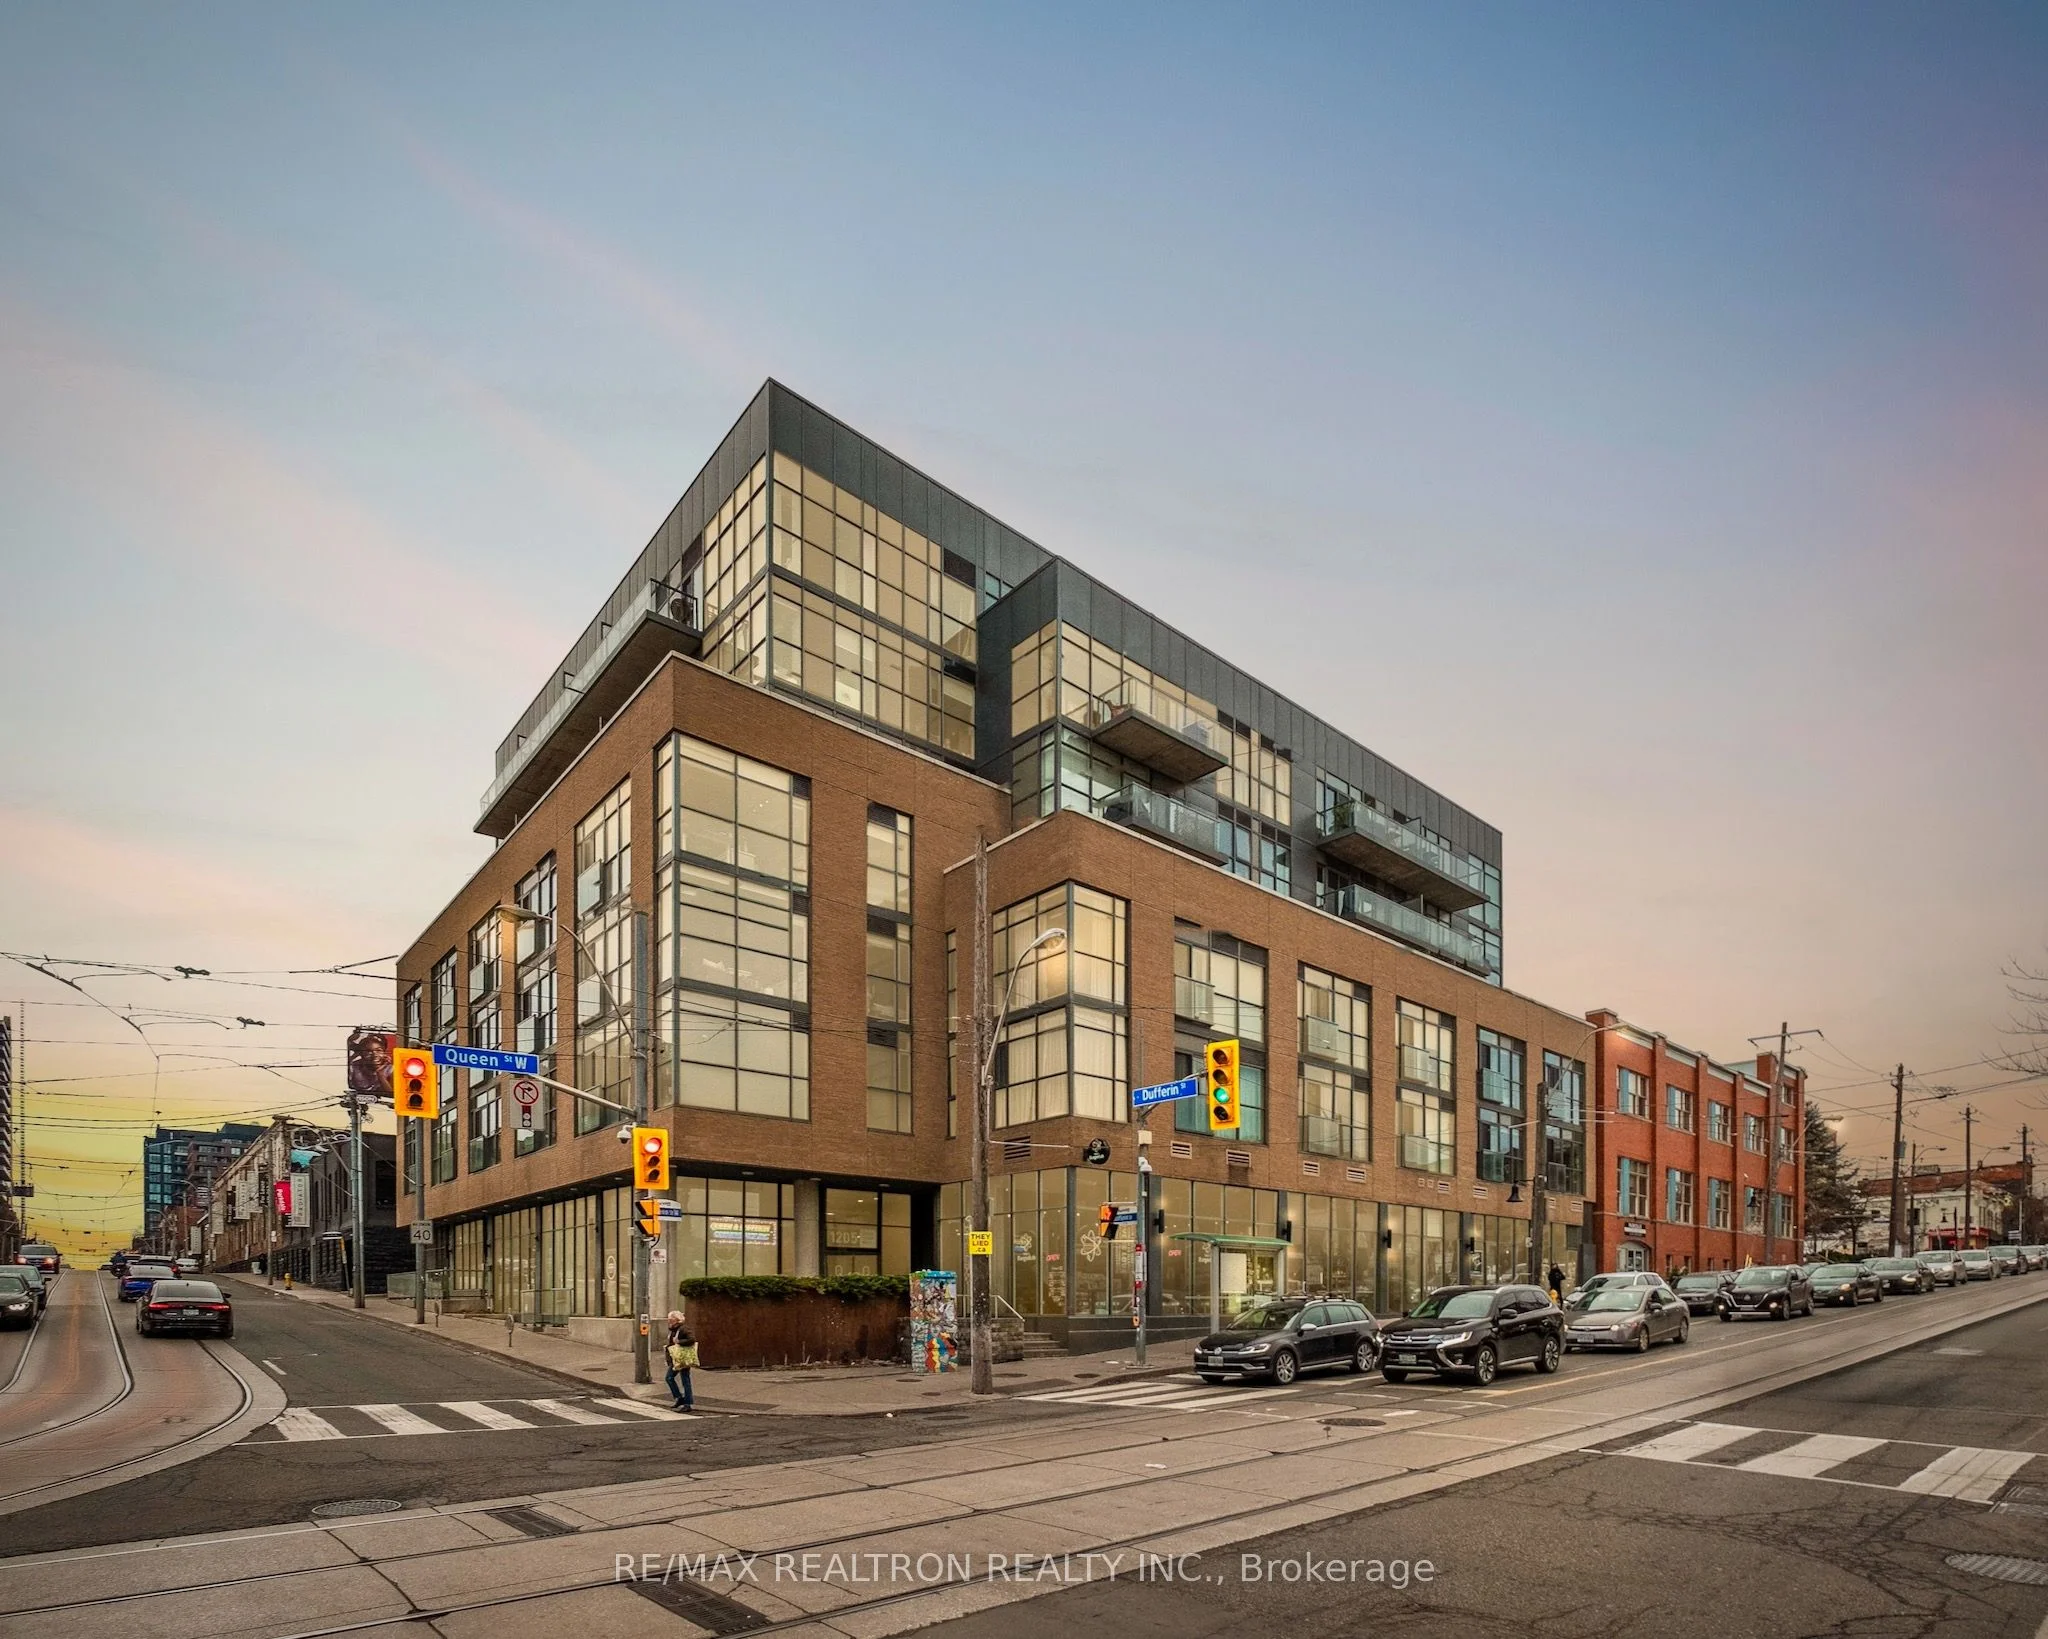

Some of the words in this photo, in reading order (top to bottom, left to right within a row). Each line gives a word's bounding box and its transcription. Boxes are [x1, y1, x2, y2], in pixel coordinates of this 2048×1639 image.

[444, 1049, 499, 1067] Queen
[504, 1055, 513, 1063] St
[515, 1056, 528, 1070] W
[1142, 1085, 1179, 1101] Dufferin
[413, 1230, 430, 1241] 40
[830, 1231, 858, 1244] 1205
